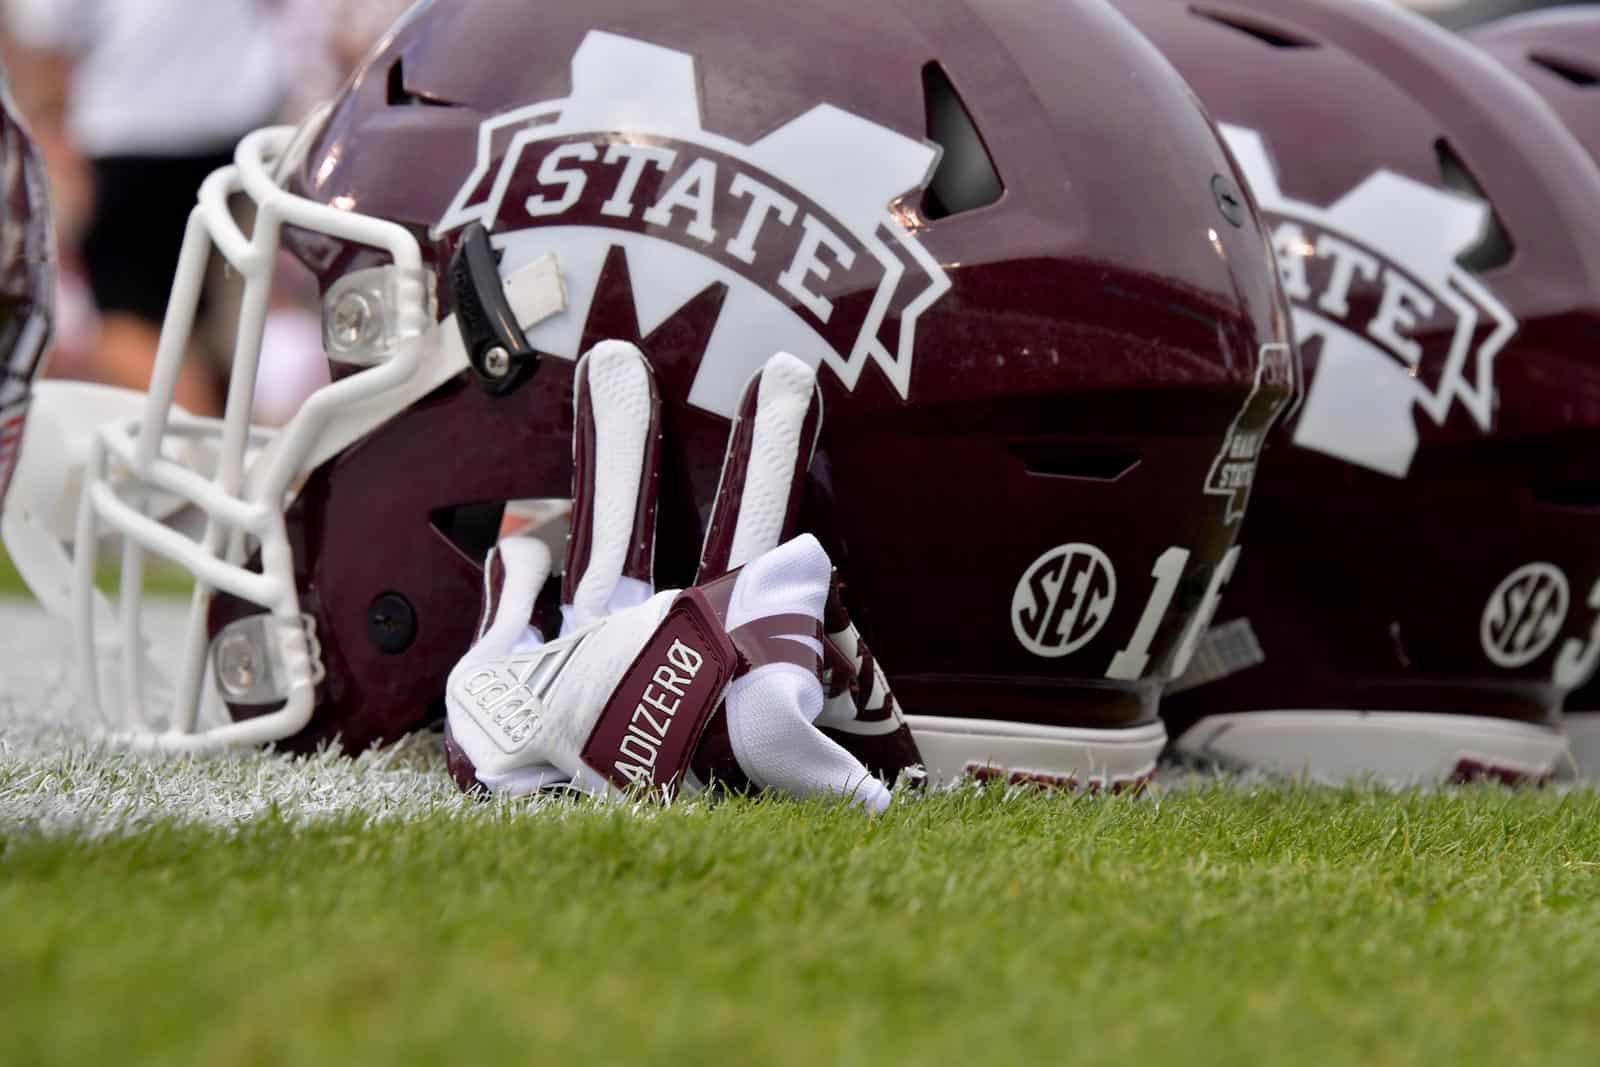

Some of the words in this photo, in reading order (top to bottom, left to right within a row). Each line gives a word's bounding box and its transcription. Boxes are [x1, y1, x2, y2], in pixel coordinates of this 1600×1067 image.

[524, 142, 857, 323] STATE
[1270, 221, 1435, 370] ATE
[1015, 548, 1113, 652] SEC
[464, 669, 543, 743] adidas
